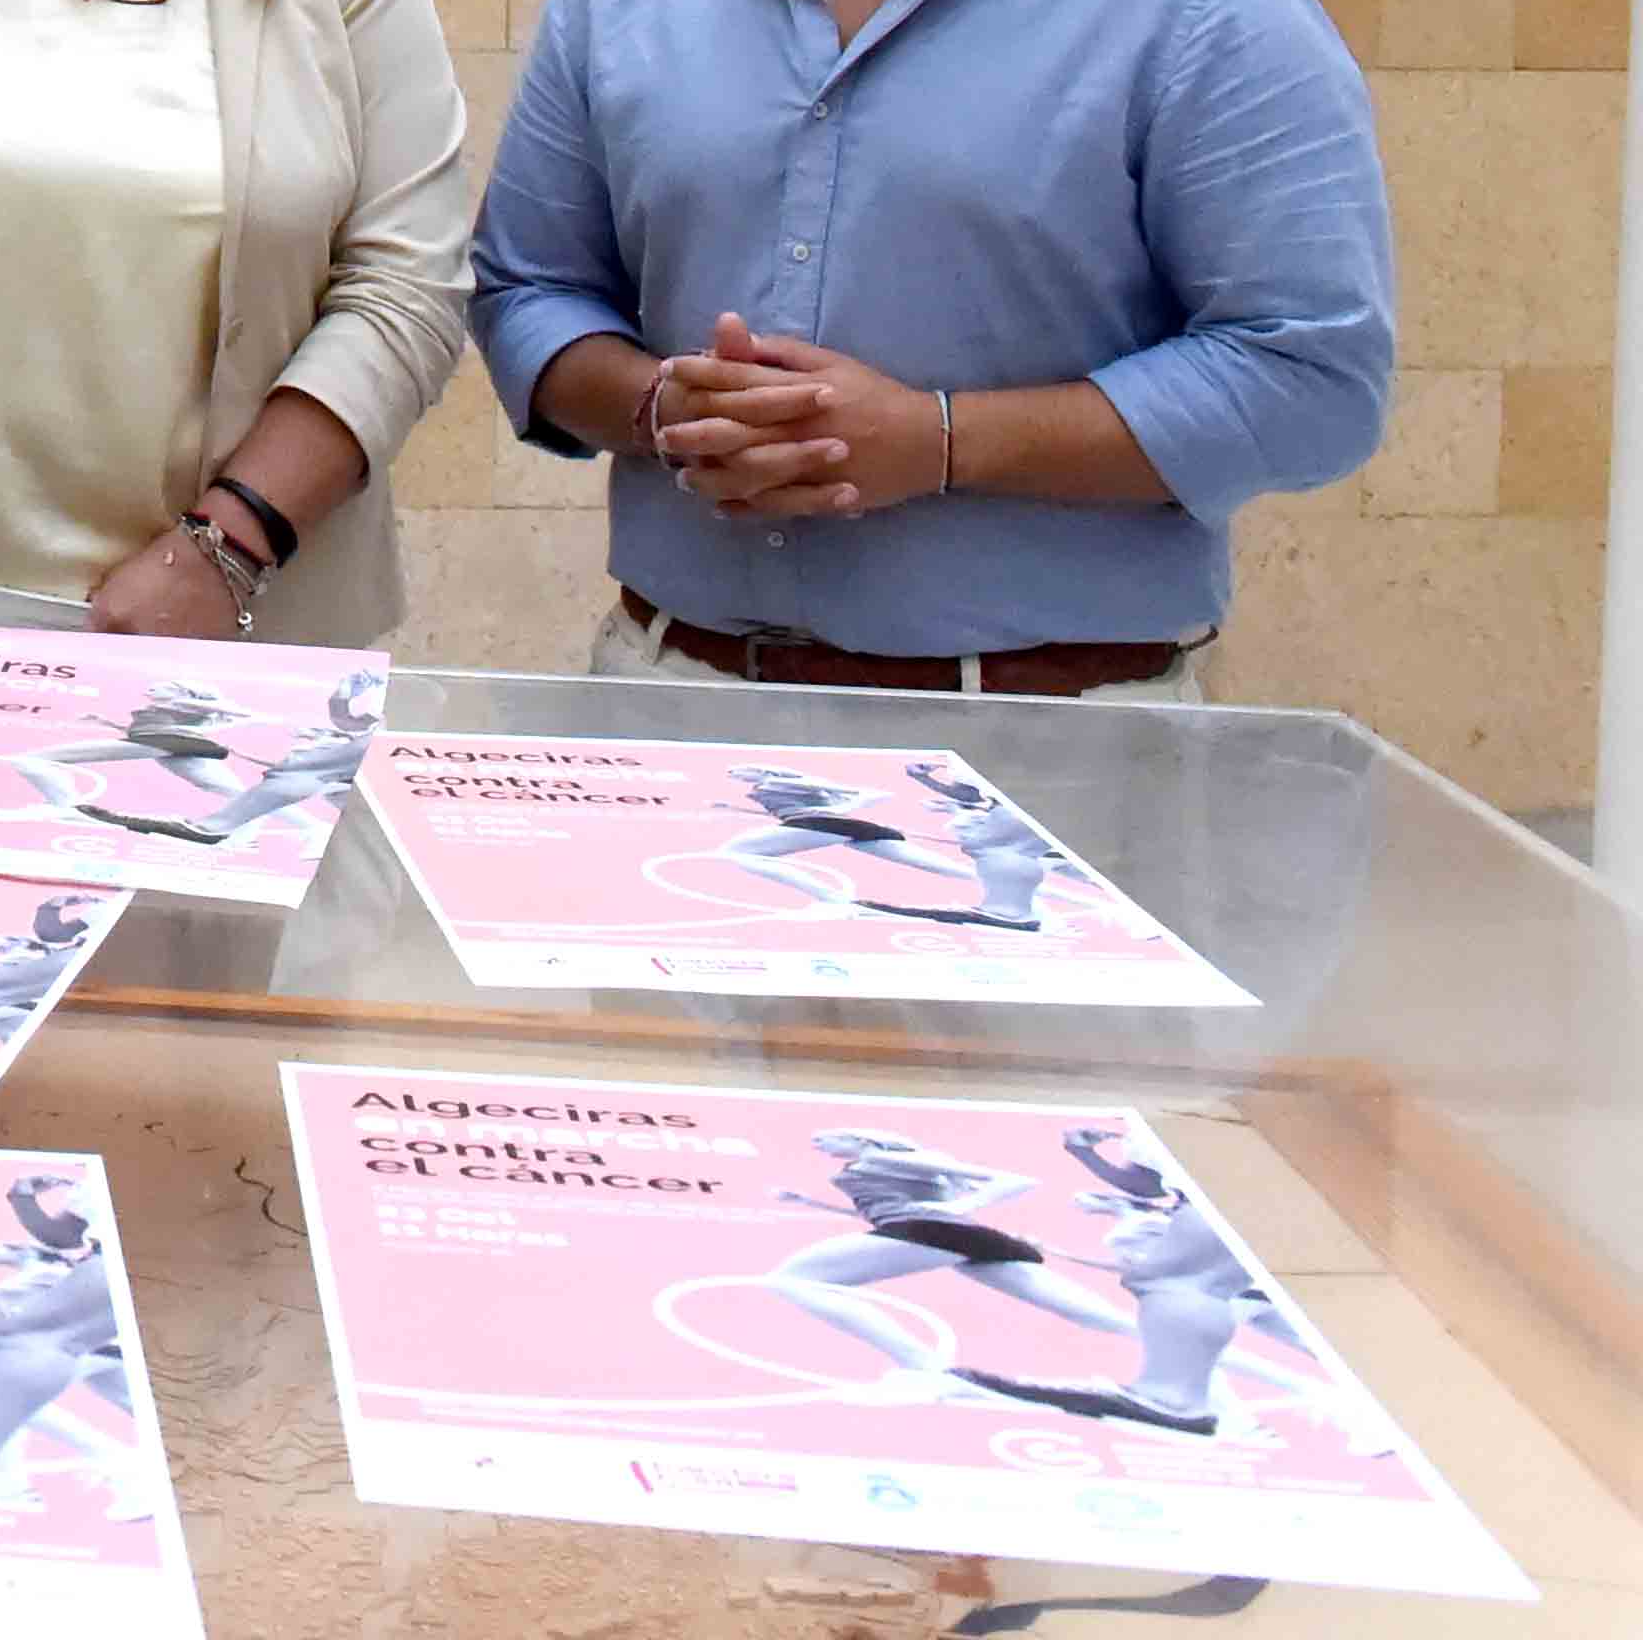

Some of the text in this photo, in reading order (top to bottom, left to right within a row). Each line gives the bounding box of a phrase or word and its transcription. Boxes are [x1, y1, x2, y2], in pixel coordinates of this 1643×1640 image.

[352, 1092, 698, 1129] Algeciras
[353, 1116, 758, 1157] en marcha
[361, 1137, 606, 1167] contra
[366, 1157, 724, 1194] el cáncer
